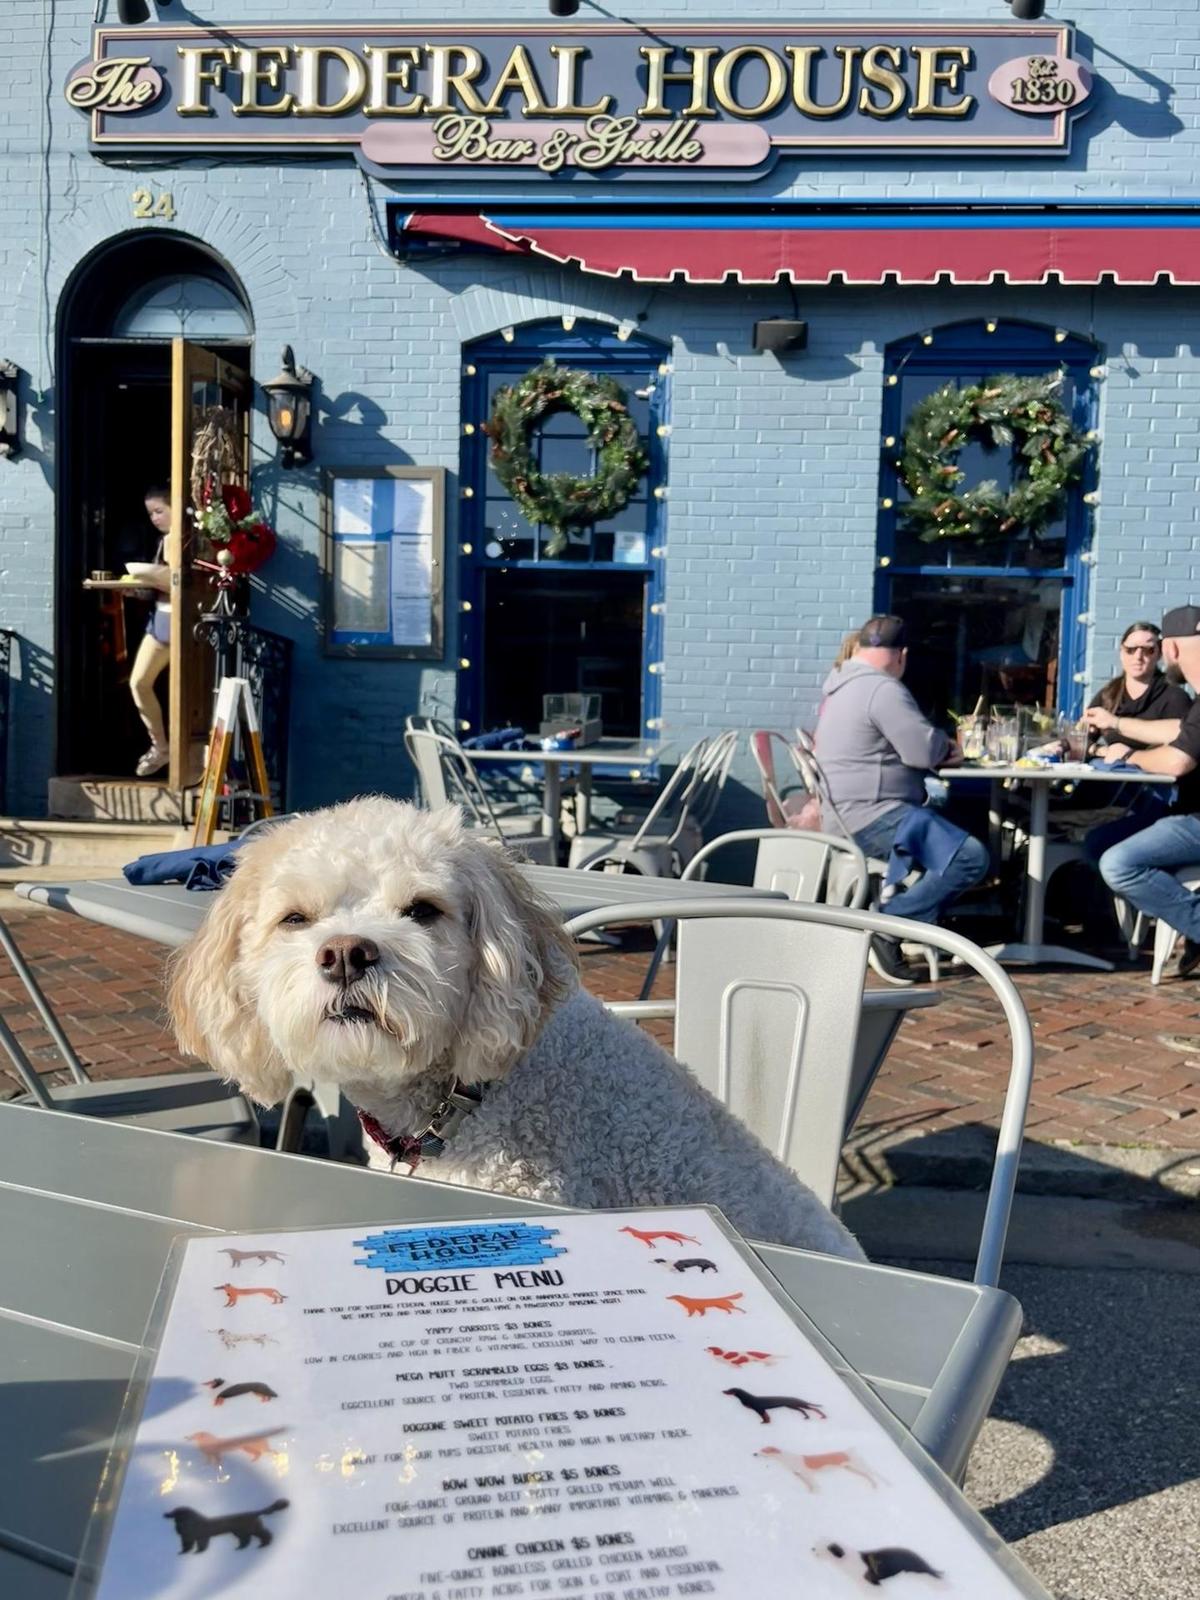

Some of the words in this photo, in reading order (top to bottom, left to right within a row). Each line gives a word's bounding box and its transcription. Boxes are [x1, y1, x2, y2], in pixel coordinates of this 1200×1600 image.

[65, 57, 151, 109] The
[176, 43, 613, 118] FEDERAL
[637, 44, 974, 119] HOUSE
[1011, 78, 1076, 105] 1830
[433, 114, 534, 162] Bar
[538, 129, 577, 172] &
[574, 114, 704, 169] Grille
[131, 187, 177, 221] 24
[388, 1229, 531, 1254] FEDERAL
[411, 1241, 524, 1261] HOUSE
[386, 1273, 478, 1296] DOGGIE
[493, 1269, 565, 1289] MENU
[366, 1303, 394, 1311] VISITING
[536, 1293, 570, 1301] ANNAPOLIS
[463, 1306, 491, 1314] FRIENDS
[569, 1299, 598, 1307] AMAZING
[379, 1341, 396, 1349] ONE
[401, 1340, 417, 1348] CUP
[436, 1336, 473, 1345] CRUNCHY
[479, 1335, 497, 1343] RAW
[502, 1333, 509, 1341] &
[514, 1331, 554, 1340] UNCOOKED
[425, 1327, 454, 1336] YAPPY
[459, 1324, 500, 1333] CARROTS
[504, 1322, 519, 1331] $3
[523, 1320, 552, 1329] BONES
[304, 1357, 323, 1365] LOW
[329, 1355, 337, 1363] IN
[343, 1353, 383, 1362] CALORIES
[387, 1351, 404, 1359] AND
[409, 1349, 429, 1357] HIGH
[446, 1347, 471, 1355] FIBER
[532, 1340, 575, 1350] EXCELLENT
[580, 1338, 599, 1346] WAY
[619, 1335, 646, 1344] CLEAN
[396, 1373, 424, 1382] MEGA
[429, 1370, 456, 1380] MUTT
[462, 1366, 520, 1377] SCRAMBLED
[524, 1364, 549, 1373] EGGS
[554, 1362, 569, 1371] $3
[573, 1360, 605, 1369] BONES
[449, 1382, 469, 1390] TWO
[474, 1377, 525, 1388] SCRAMBLED
[402, 1396, 437, 1406] SOURCE
[442, 1394, 454, 1402] OF
[503, 1387, 549, 1398] ESSENTIAL
[554, 1385, 582, 1394] FATTY
[589, 1383, 605, 1391] AND
[611, 1381, 637, 1390] AMINO
[403, 1421, 447, 1433] DOGGONE
[454, 1417, 489, 1429] SWEET
[495, 1415, 534, 1426] POTATO
[539, 1412, 569, 1423] FRIES
[573, 1410, 589, 1420] $3
[593, 1407, 627, 1418] BONES
[468, 1431, 500, 1441] SWEET
[506, 1428, 540, 1438] POTATO
[544, 1425, 572, 1435] FRIES
[346, 1453, 378, 1466] REAT
[384, 1453, 402, 1463] FOR
[467, 1444, 512, 1456] DIGESTIVE
[558, 1439, 576, 1448] AND
[580, 1436, 601, 1446] HIGH
[606, 1435, 616, 1444] IN
[620, 1431, 656, 1443] DIETARY
[442, 1479, 468, 1491] BOW
[474, 1475, 506, 1488] WOW
[512, 1471, 554, 1485] BURGER
[561, 1468, 579, 1481] $5
[584, 1464, 621, 1478] BONES
[455, 1494, 492, 1506] GROUND
[497, 1491, 522, 1502] BEEF
[567, 1484, 604, 1496] GRILLED
[609, 1480, 645, 1492] MEDIUM
[333, 1519, 390, 1535] EXCELLENT
[398, 1515, 436, 1528] SOURCE
[443, 1513, 456, 1524] OF
[463, 1508, 505, 1522] PROTEIN
[510, 1506, 530, 1517] AND
[536, 1503, 562, 1516] MANY
[569, 1497, 621, 1512] IMPORTANT
[628, 1493, 674, 1506] VITAMINS
[678, 1491, 688, 1501] &
[467, 1544, 510, 1561] CANINE
[514, 1539, 566, 1556] CHICKEN
[571, 1536, 591, 1550] $5
[596, 1532, 636, 1547] BONES
[492, 1561, 547, 1577] BONELESS
[553, 1556, 593, 1571] GRILLED
[600, 1551, 644, 1566] CHICKEN
[648, 1545, 690, 1560] BREAST
[492, 1582, 524, 1597] ACIDS
[530, 1579, 553, 1592] FOR
[558, 1576, 584, 1590] SKIN
[590, 1574, 599, 1586] &
[605, 1570, 632, 1584] COAT
[640, 1567, 660, 1580] AND
